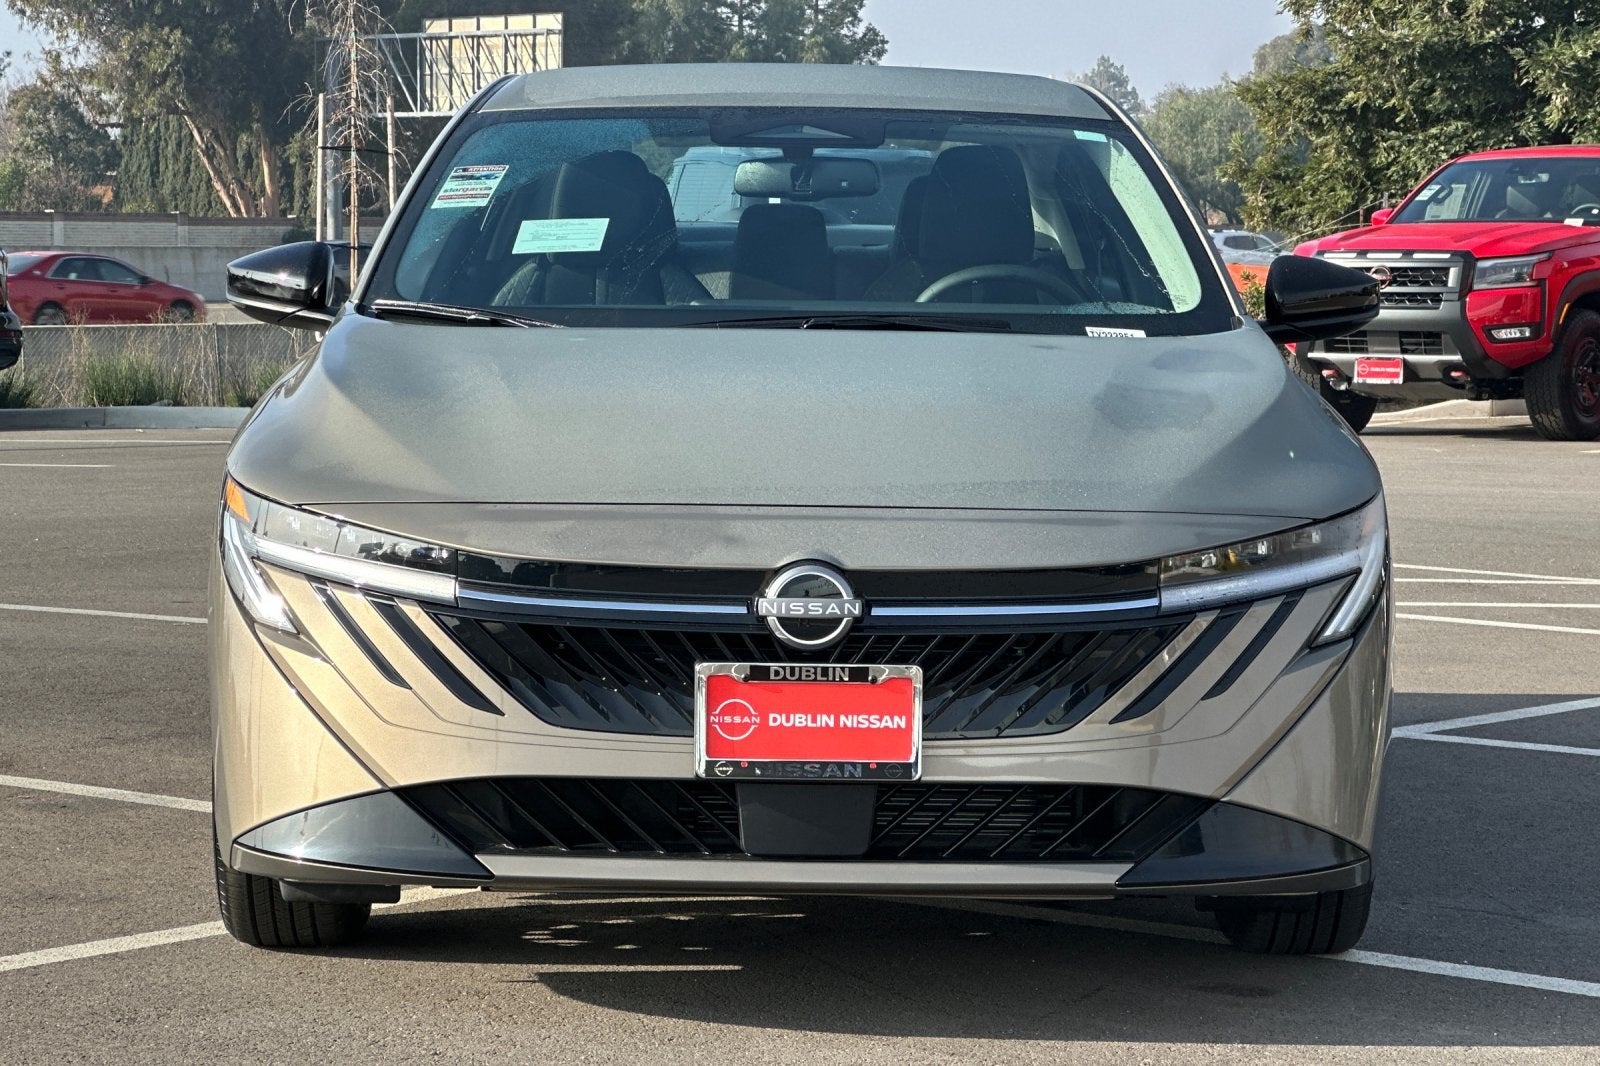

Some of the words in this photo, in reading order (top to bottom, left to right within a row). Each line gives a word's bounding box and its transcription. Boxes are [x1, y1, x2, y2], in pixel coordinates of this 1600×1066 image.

[762, 601, 859, 615] NISSAN
[769, 666, 849, 682] DUBLIN
[710, 715, 760, 724] NISSAN
[768, 713, 834, 728] DUBLIN
[839, 714, 906, 729] NISSAN
